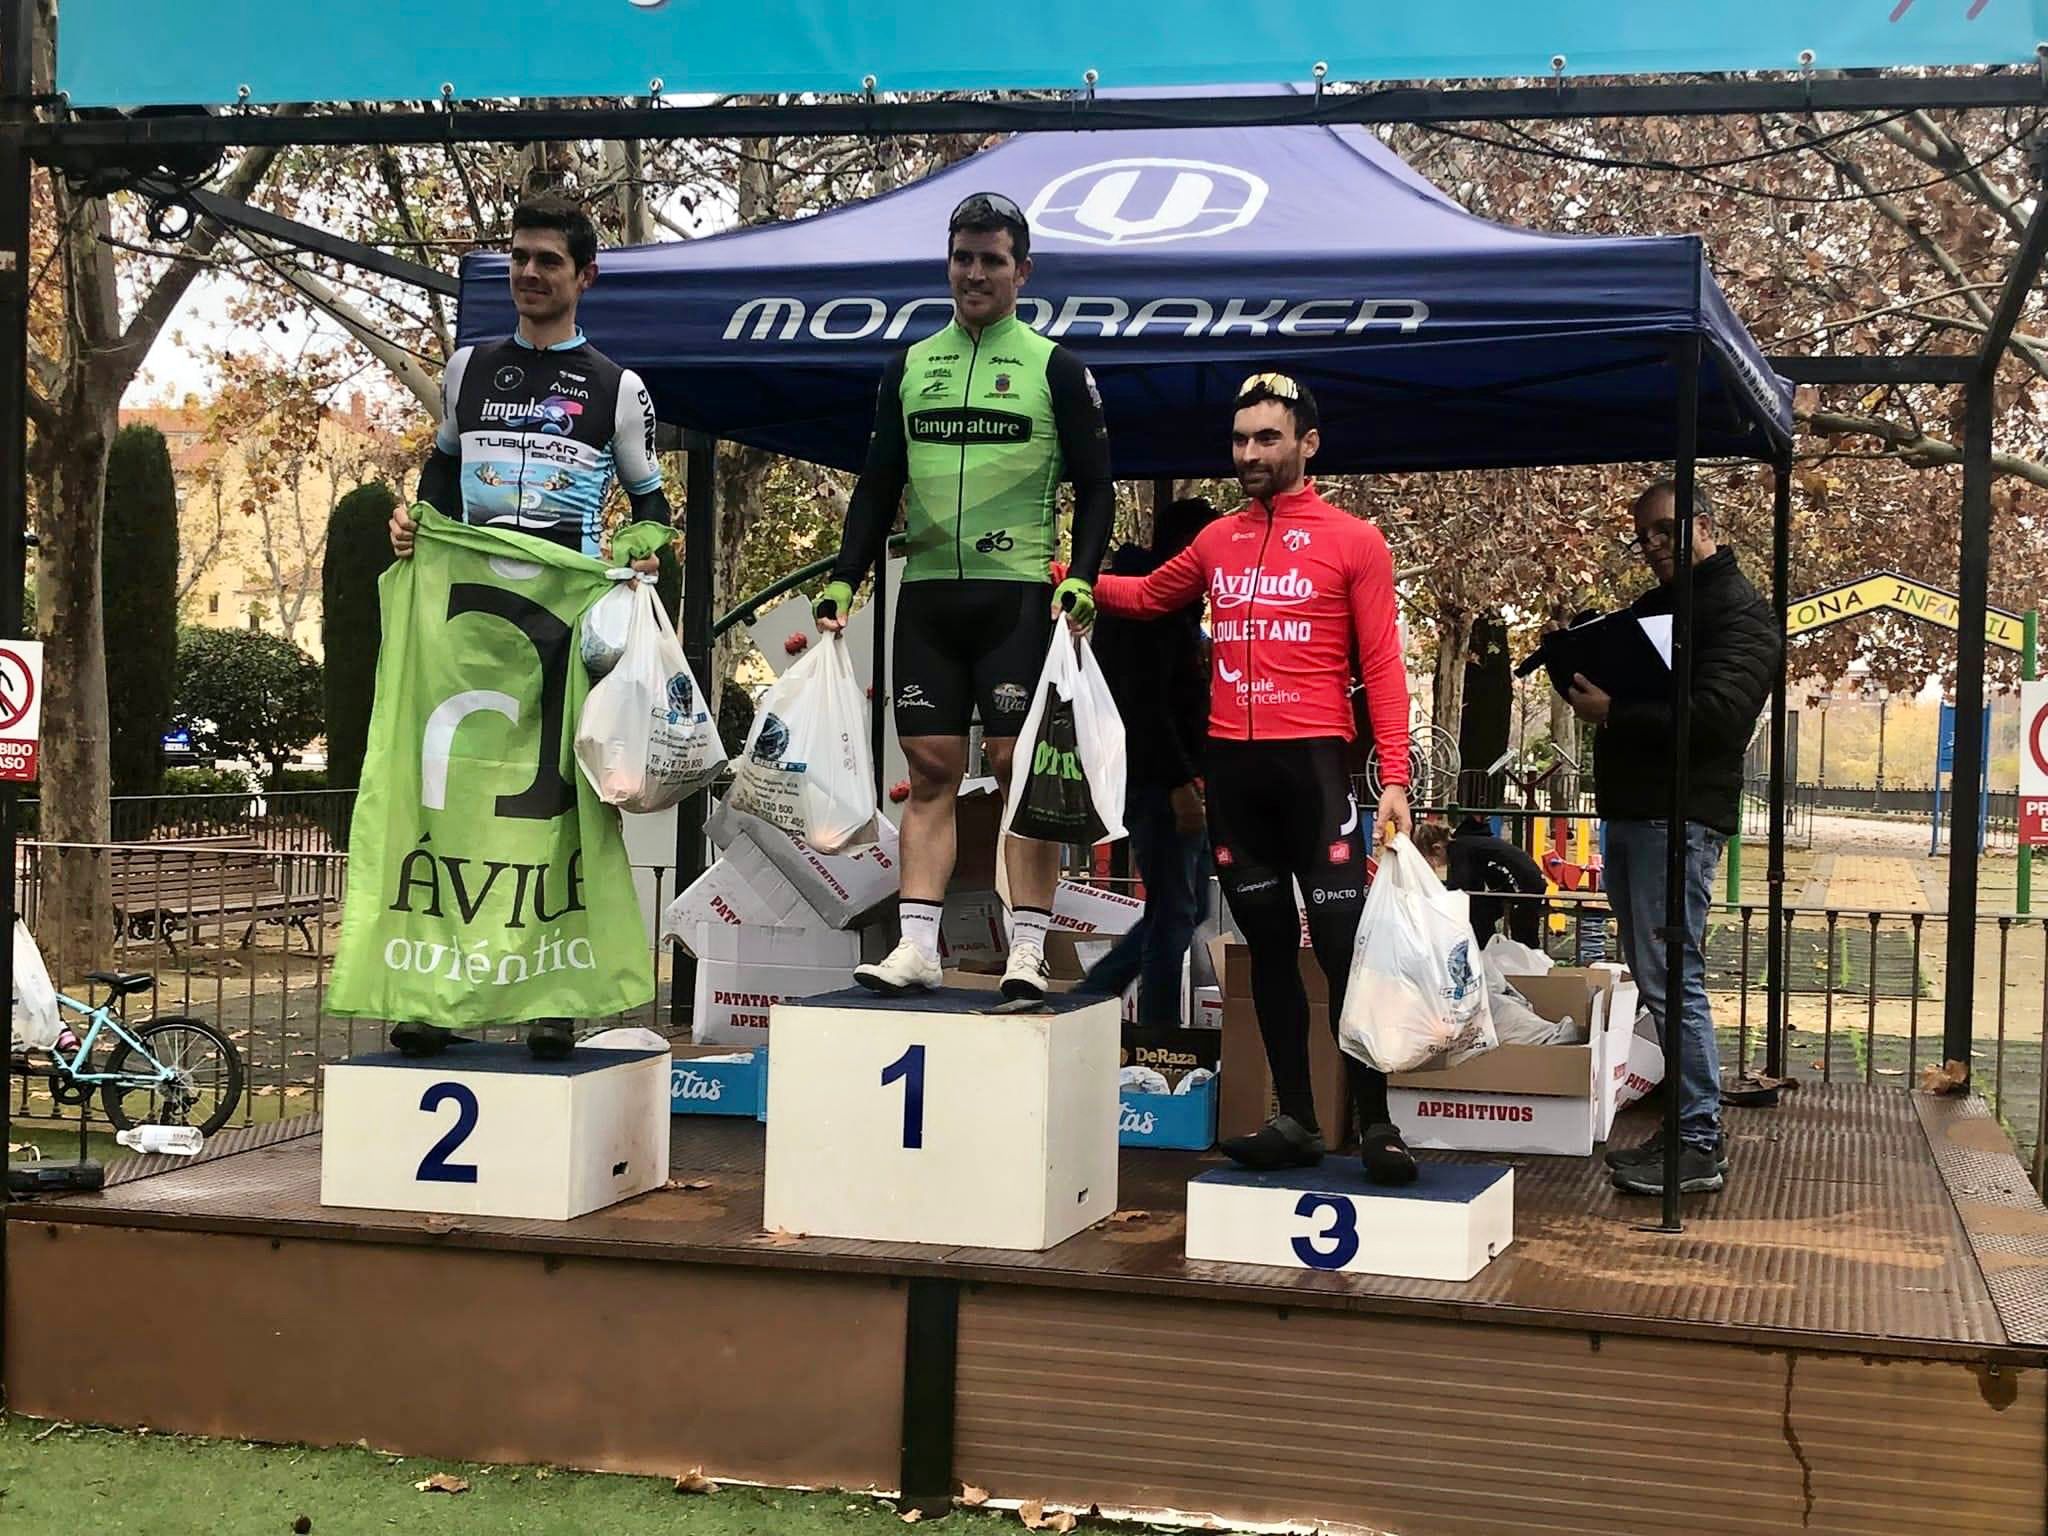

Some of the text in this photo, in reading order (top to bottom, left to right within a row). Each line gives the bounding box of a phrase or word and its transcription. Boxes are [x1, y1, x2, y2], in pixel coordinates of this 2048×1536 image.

[914, 417, 1020, 438] tanynature
[475, 437, 579, 456] TUBULAR
[1892, 584, 2010, 640] INFAIL
[1212, 618, 1312, 643] LOULETANO
[1327, 888, 1357, 901] PACTO
[714, 991, 779, 1008] PATATAS
[1136, 1047, 1198, 1065] DeRaza
[881, 1044, 926, 1149] 1
[1417, 1101, 1534, 1123] APERITIVOS
[416, 1081, 480, 1183] 2
[1291, 1192, 1359, 1271] 3
